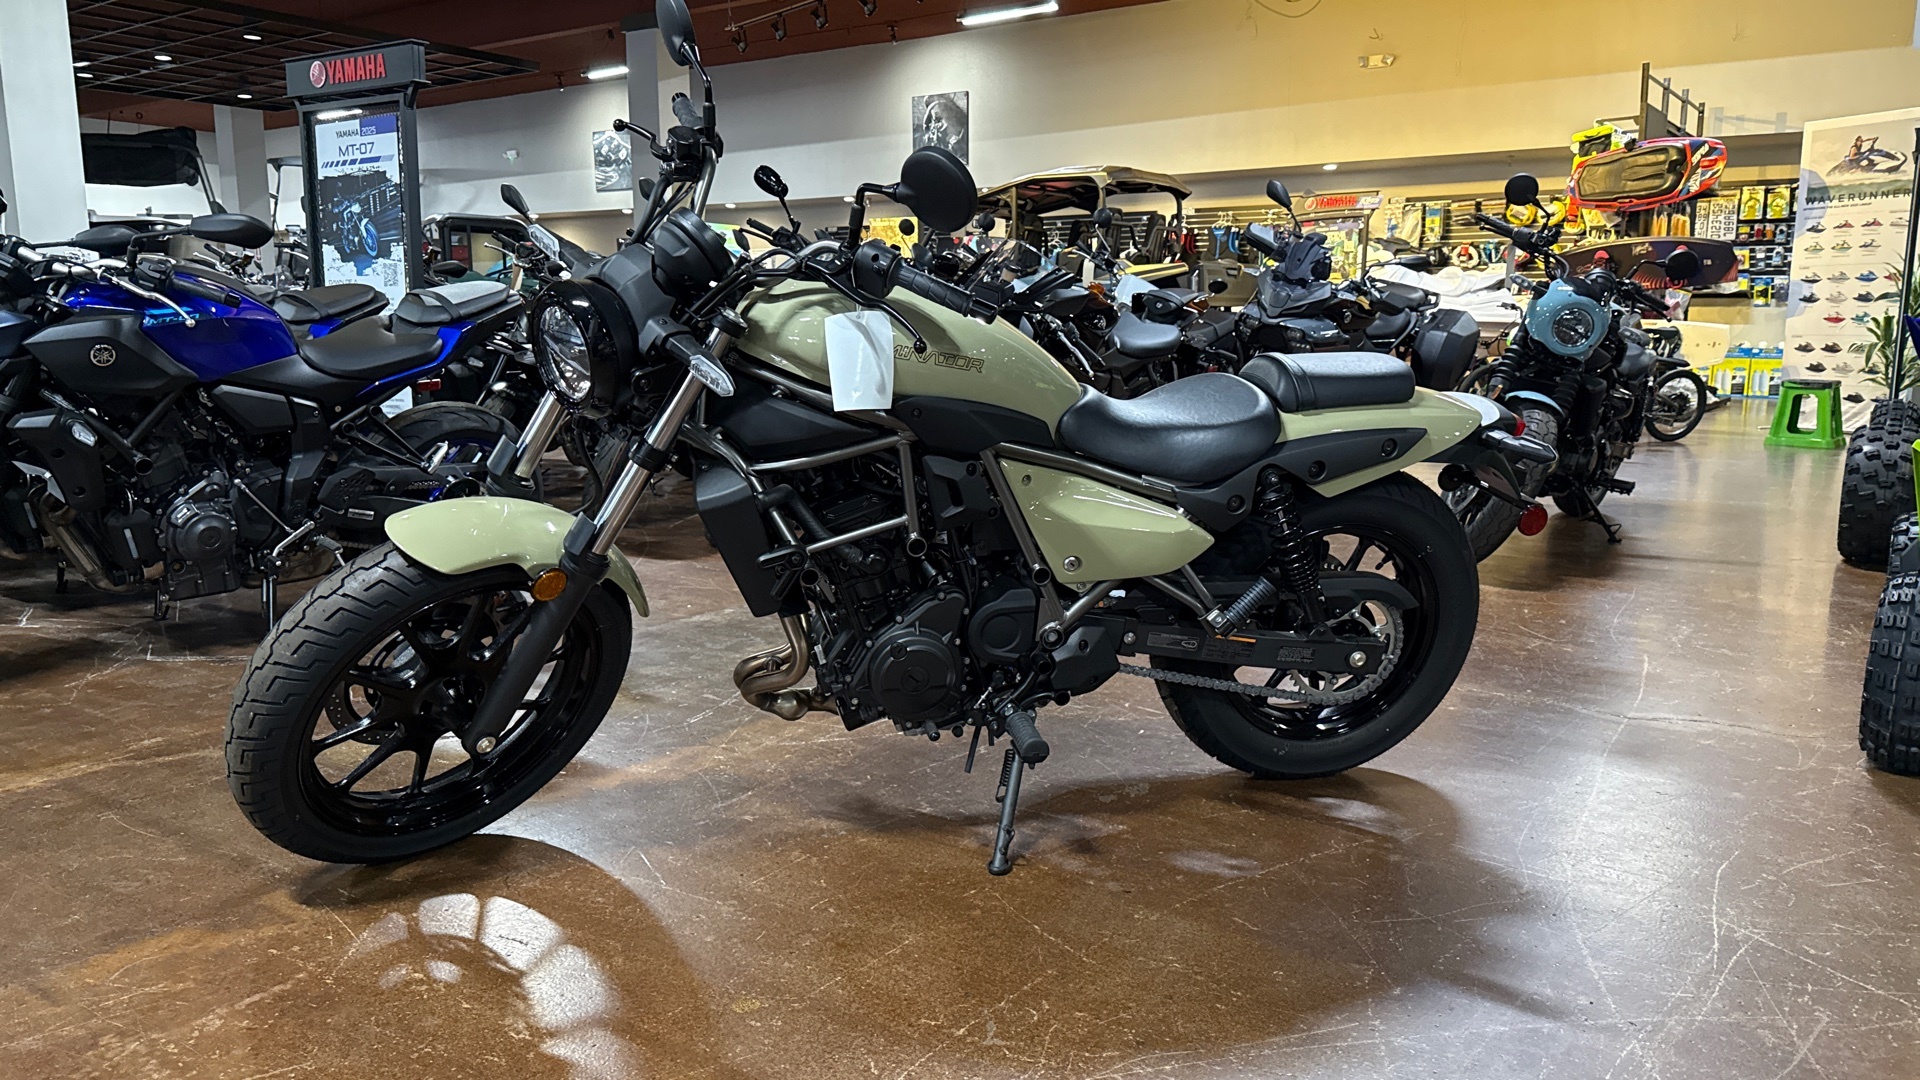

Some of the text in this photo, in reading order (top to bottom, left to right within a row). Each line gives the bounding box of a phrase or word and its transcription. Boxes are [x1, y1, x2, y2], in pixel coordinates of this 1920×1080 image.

[325, 53, 386, 84] YAMAHA
[335, 126, 377, 139] YAMAHA 2025
[338, 141, 375, 158] MT-07
[1317, 195, 1357, 208] YAMAHA
[1805, 188, 1911, 206] WAVERUNNER
[150, 314, 199, 325] MT-7
